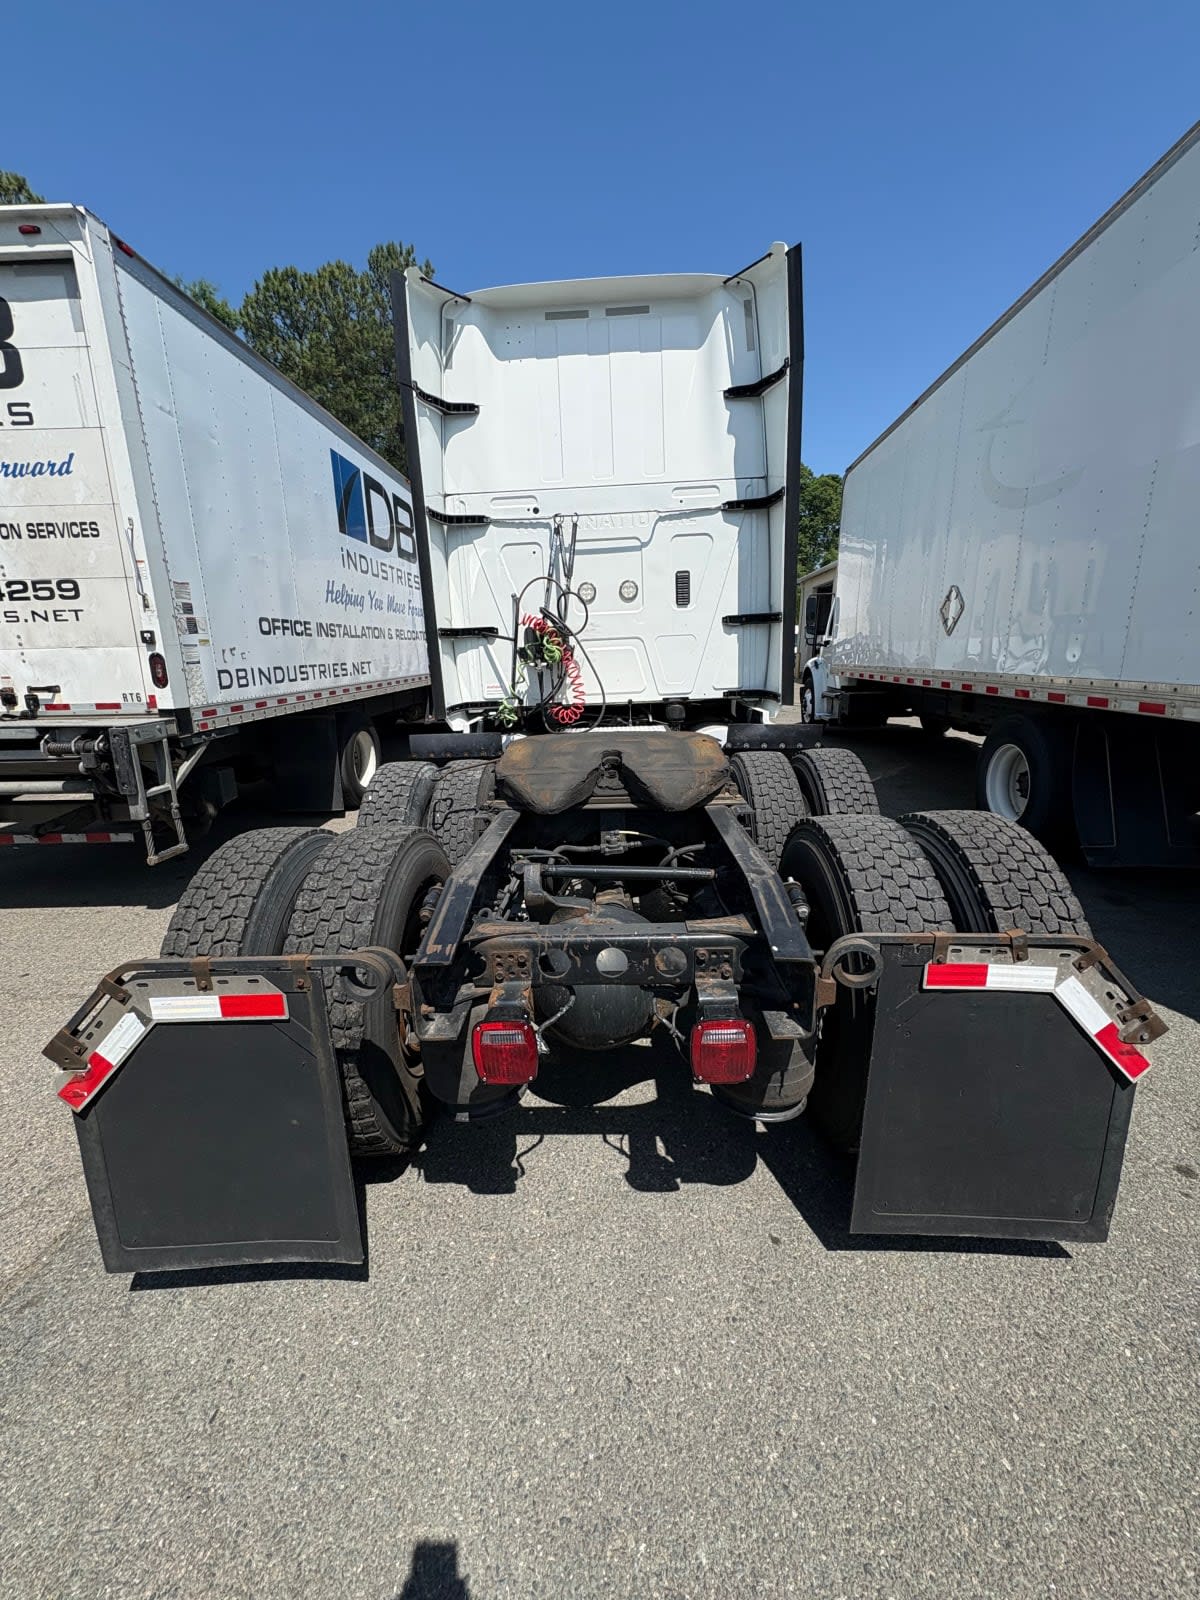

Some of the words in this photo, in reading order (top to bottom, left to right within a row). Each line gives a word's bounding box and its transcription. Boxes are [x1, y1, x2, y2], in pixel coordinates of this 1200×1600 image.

[0, 402, 34, 426] S
[363, 471, 417, 564] DB
[27, 521, 100, 539] SERVICES
[325, 580, 365, 614] Helping
[368, 589, 384, 610] You
[387, 594, 405, 614] Move
[0, 609, 84, 623] S.NET
[258, 617, 312, 638] OFFICE
[316, 622, 386, 640] INSTALLATION
[387, 627, 394, 639] &
[218, 661, 372, 690] DBINDUSTRIES.NET
[122, 692, 142, 703] RT6
